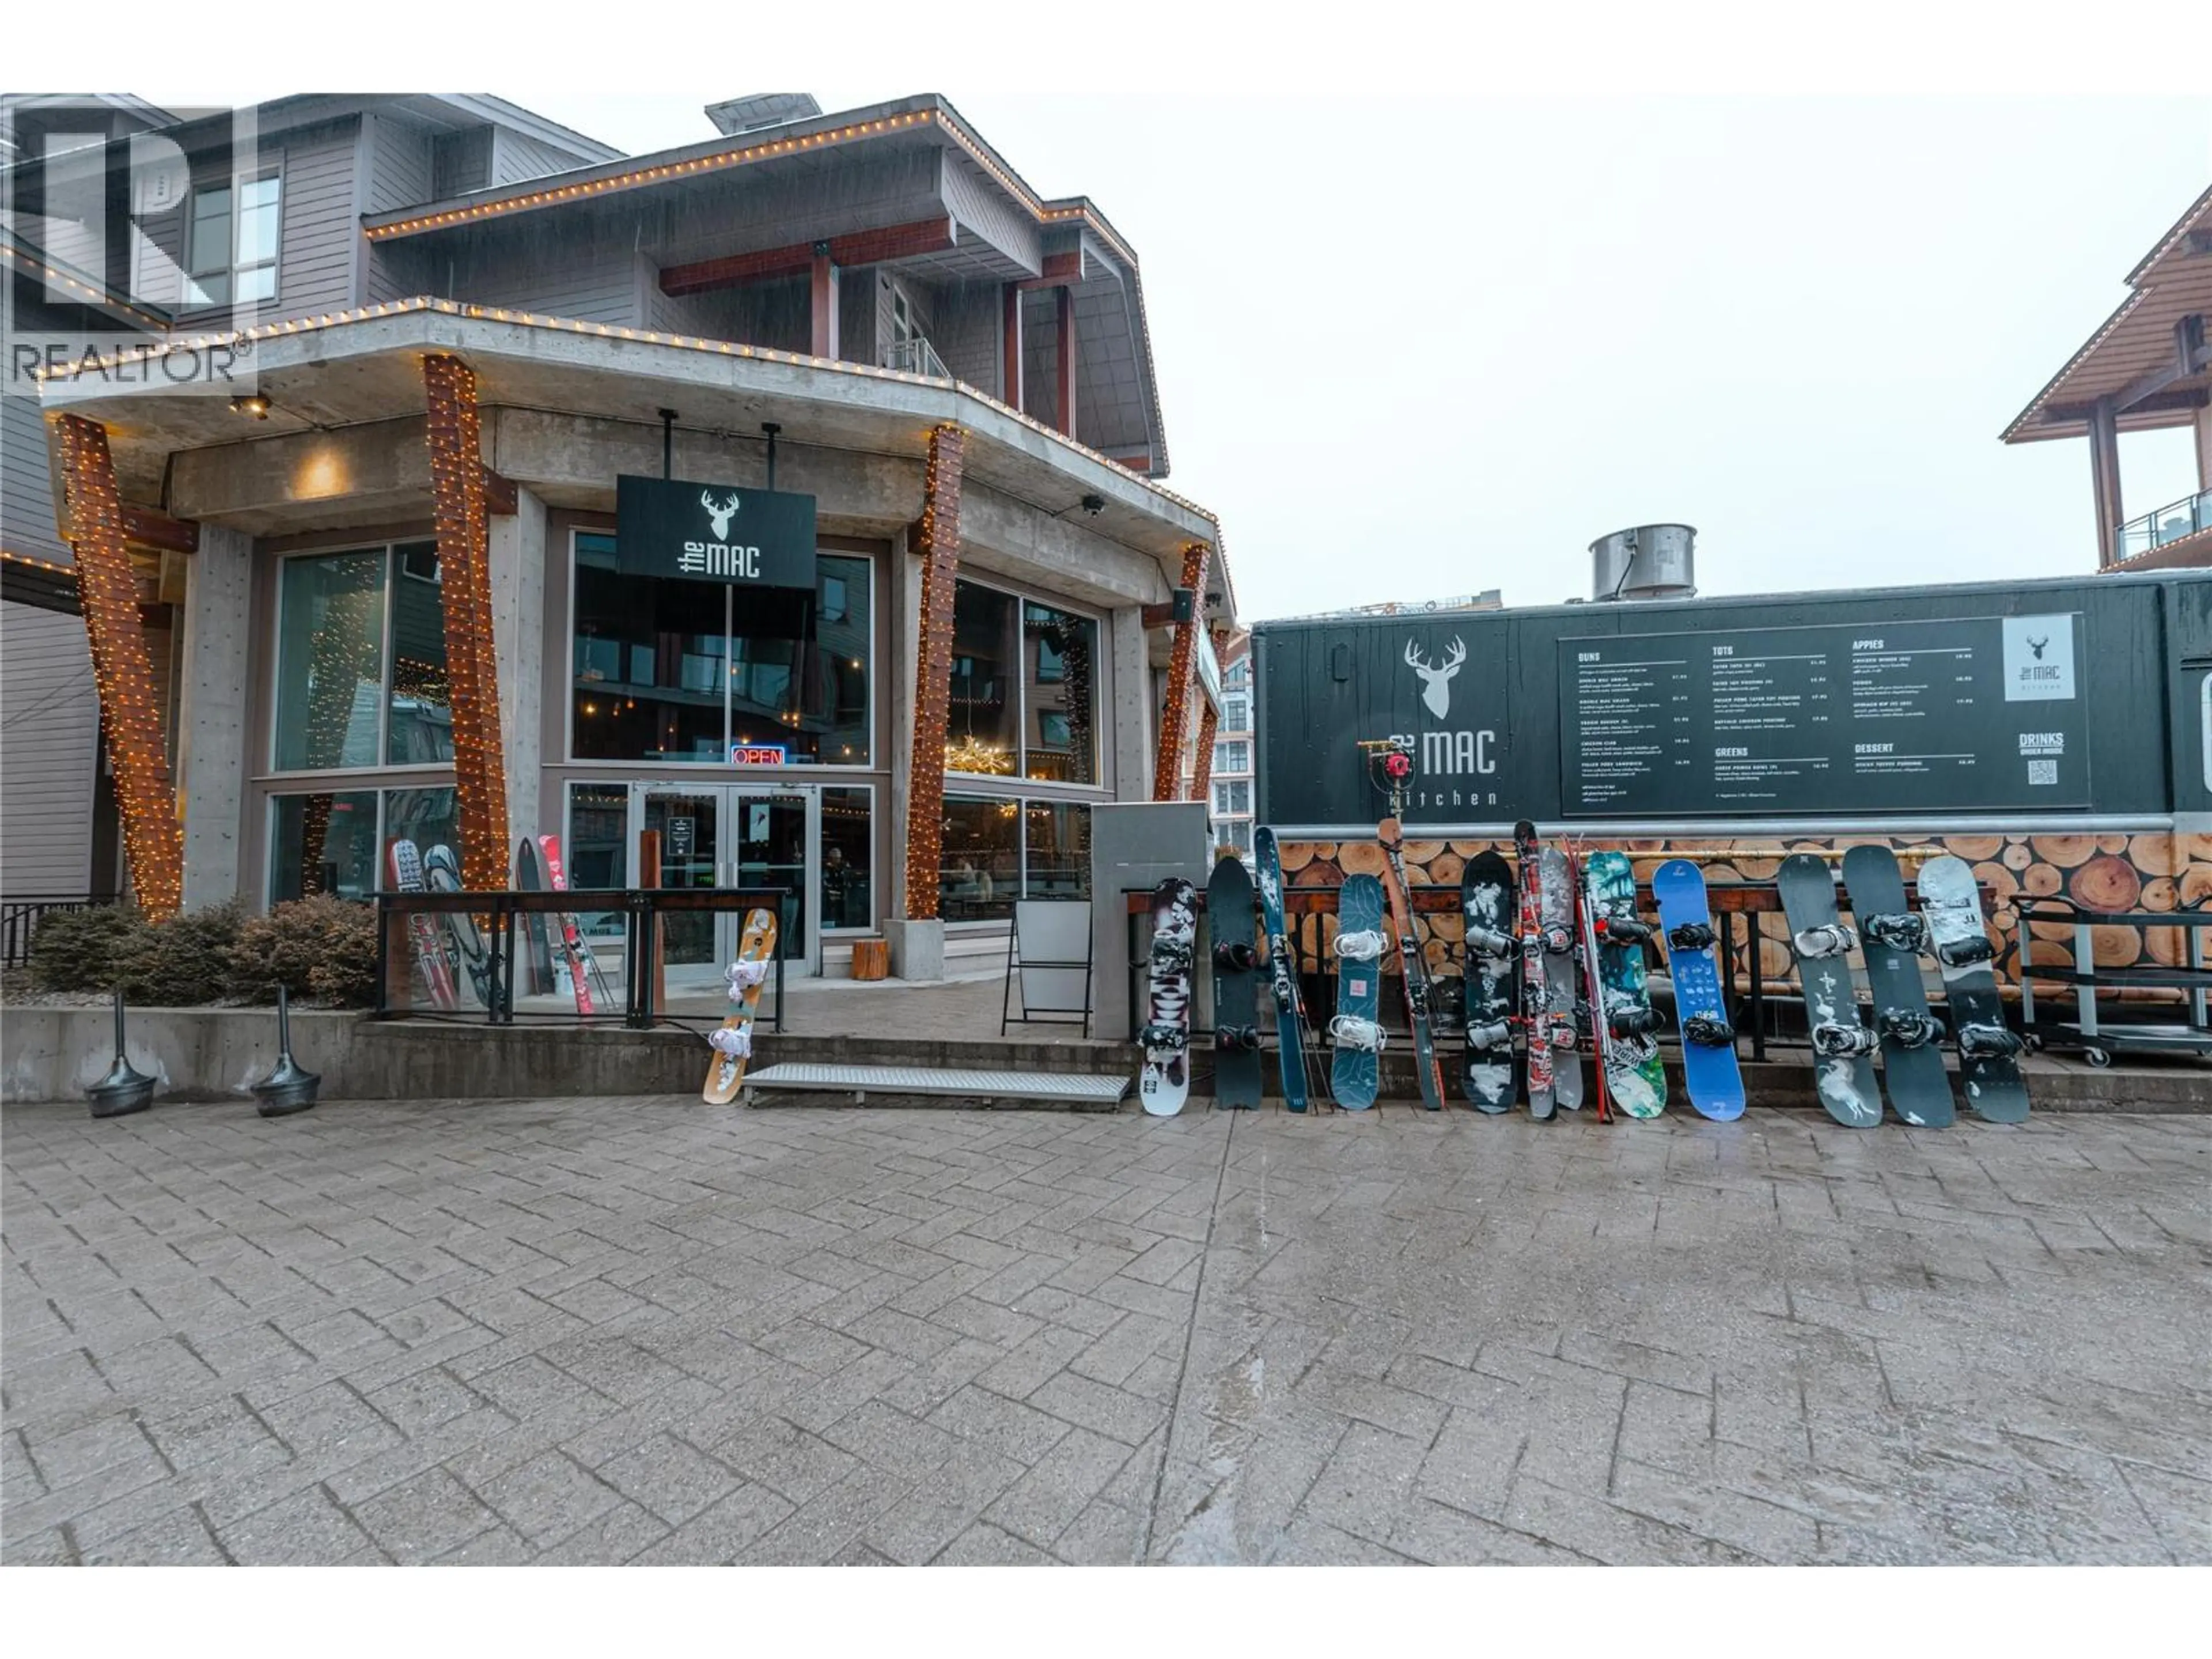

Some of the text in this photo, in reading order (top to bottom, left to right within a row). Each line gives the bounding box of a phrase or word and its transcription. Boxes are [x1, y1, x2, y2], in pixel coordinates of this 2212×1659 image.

[677, 541, 760, 578] the MAC
[1853, 639, 1884, 650] APPIES
[2033, 665, 2061, 680] MAC
[2020, 733, 2063, 745] DRINKS
[1423, 730, 1495, 775] MAC
[1715, 747, 1748, 757] GREENS
[1855, 743, 1893, 753] DESSERT
[734, 749, 782, 764] OPEN
